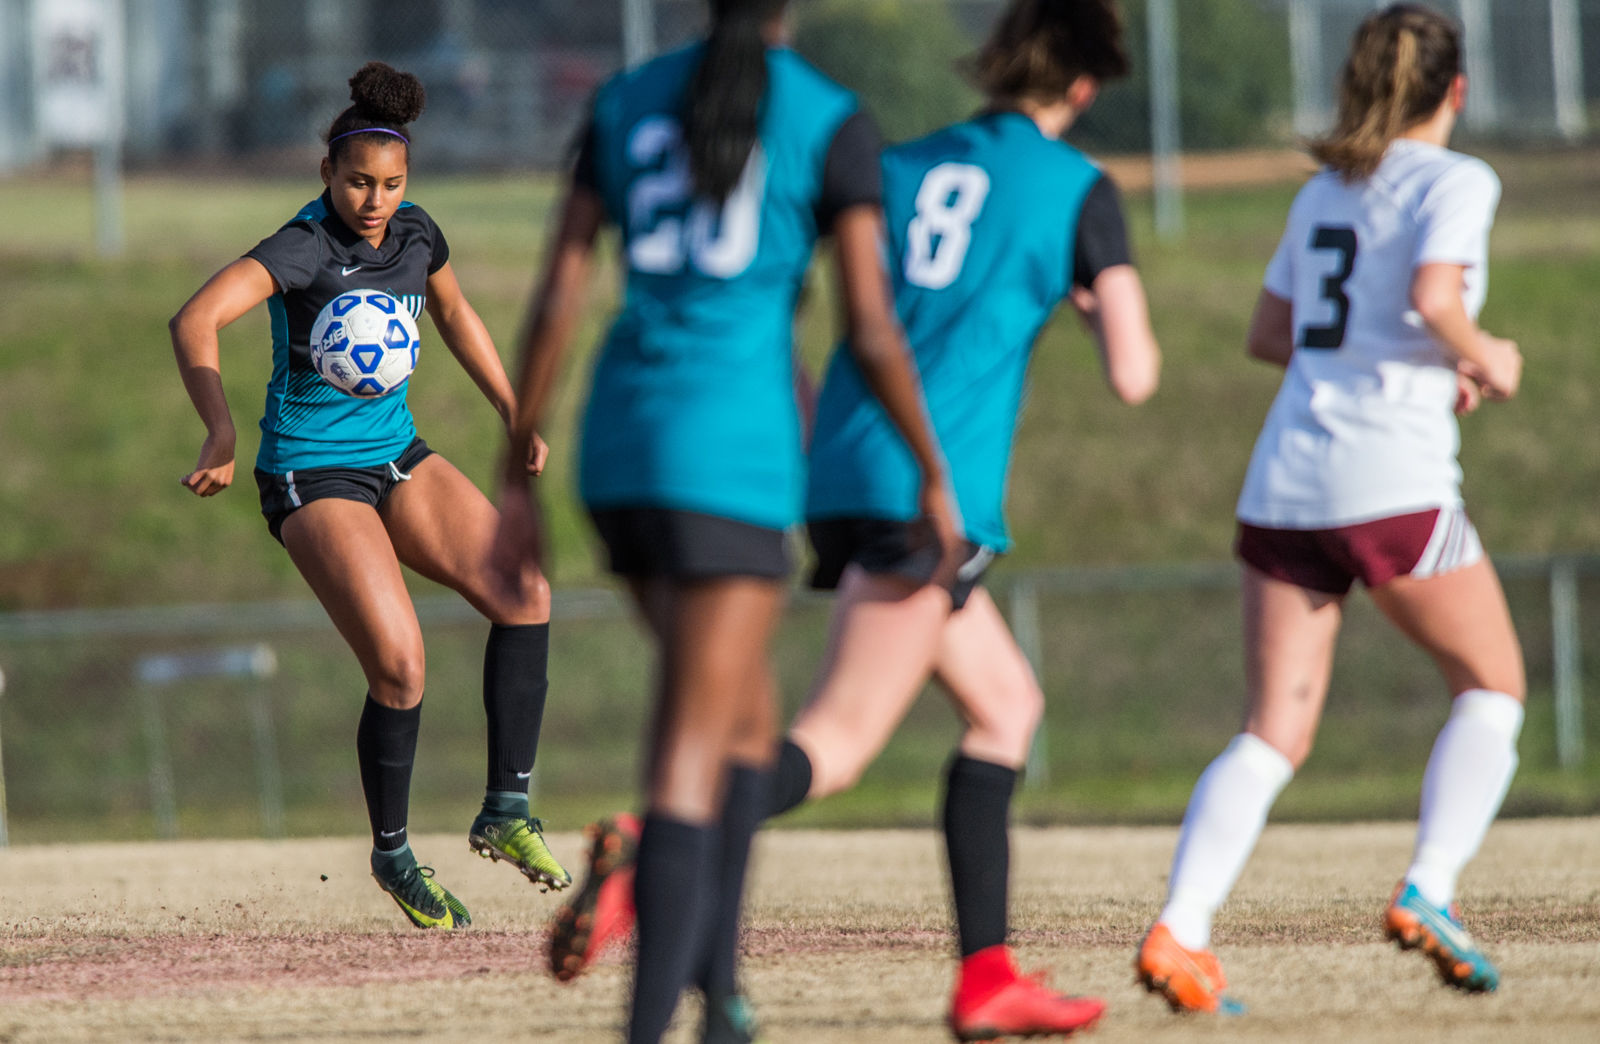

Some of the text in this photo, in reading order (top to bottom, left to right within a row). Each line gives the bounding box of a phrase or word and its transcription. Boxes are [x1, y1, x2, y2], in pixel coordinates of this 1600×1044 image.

[627, 115, 765, 280] 20
[906, 162, 989, 289] 8
[311, 326, 347, 363] BRIN
[1301, 225, 1357, 349] 3
